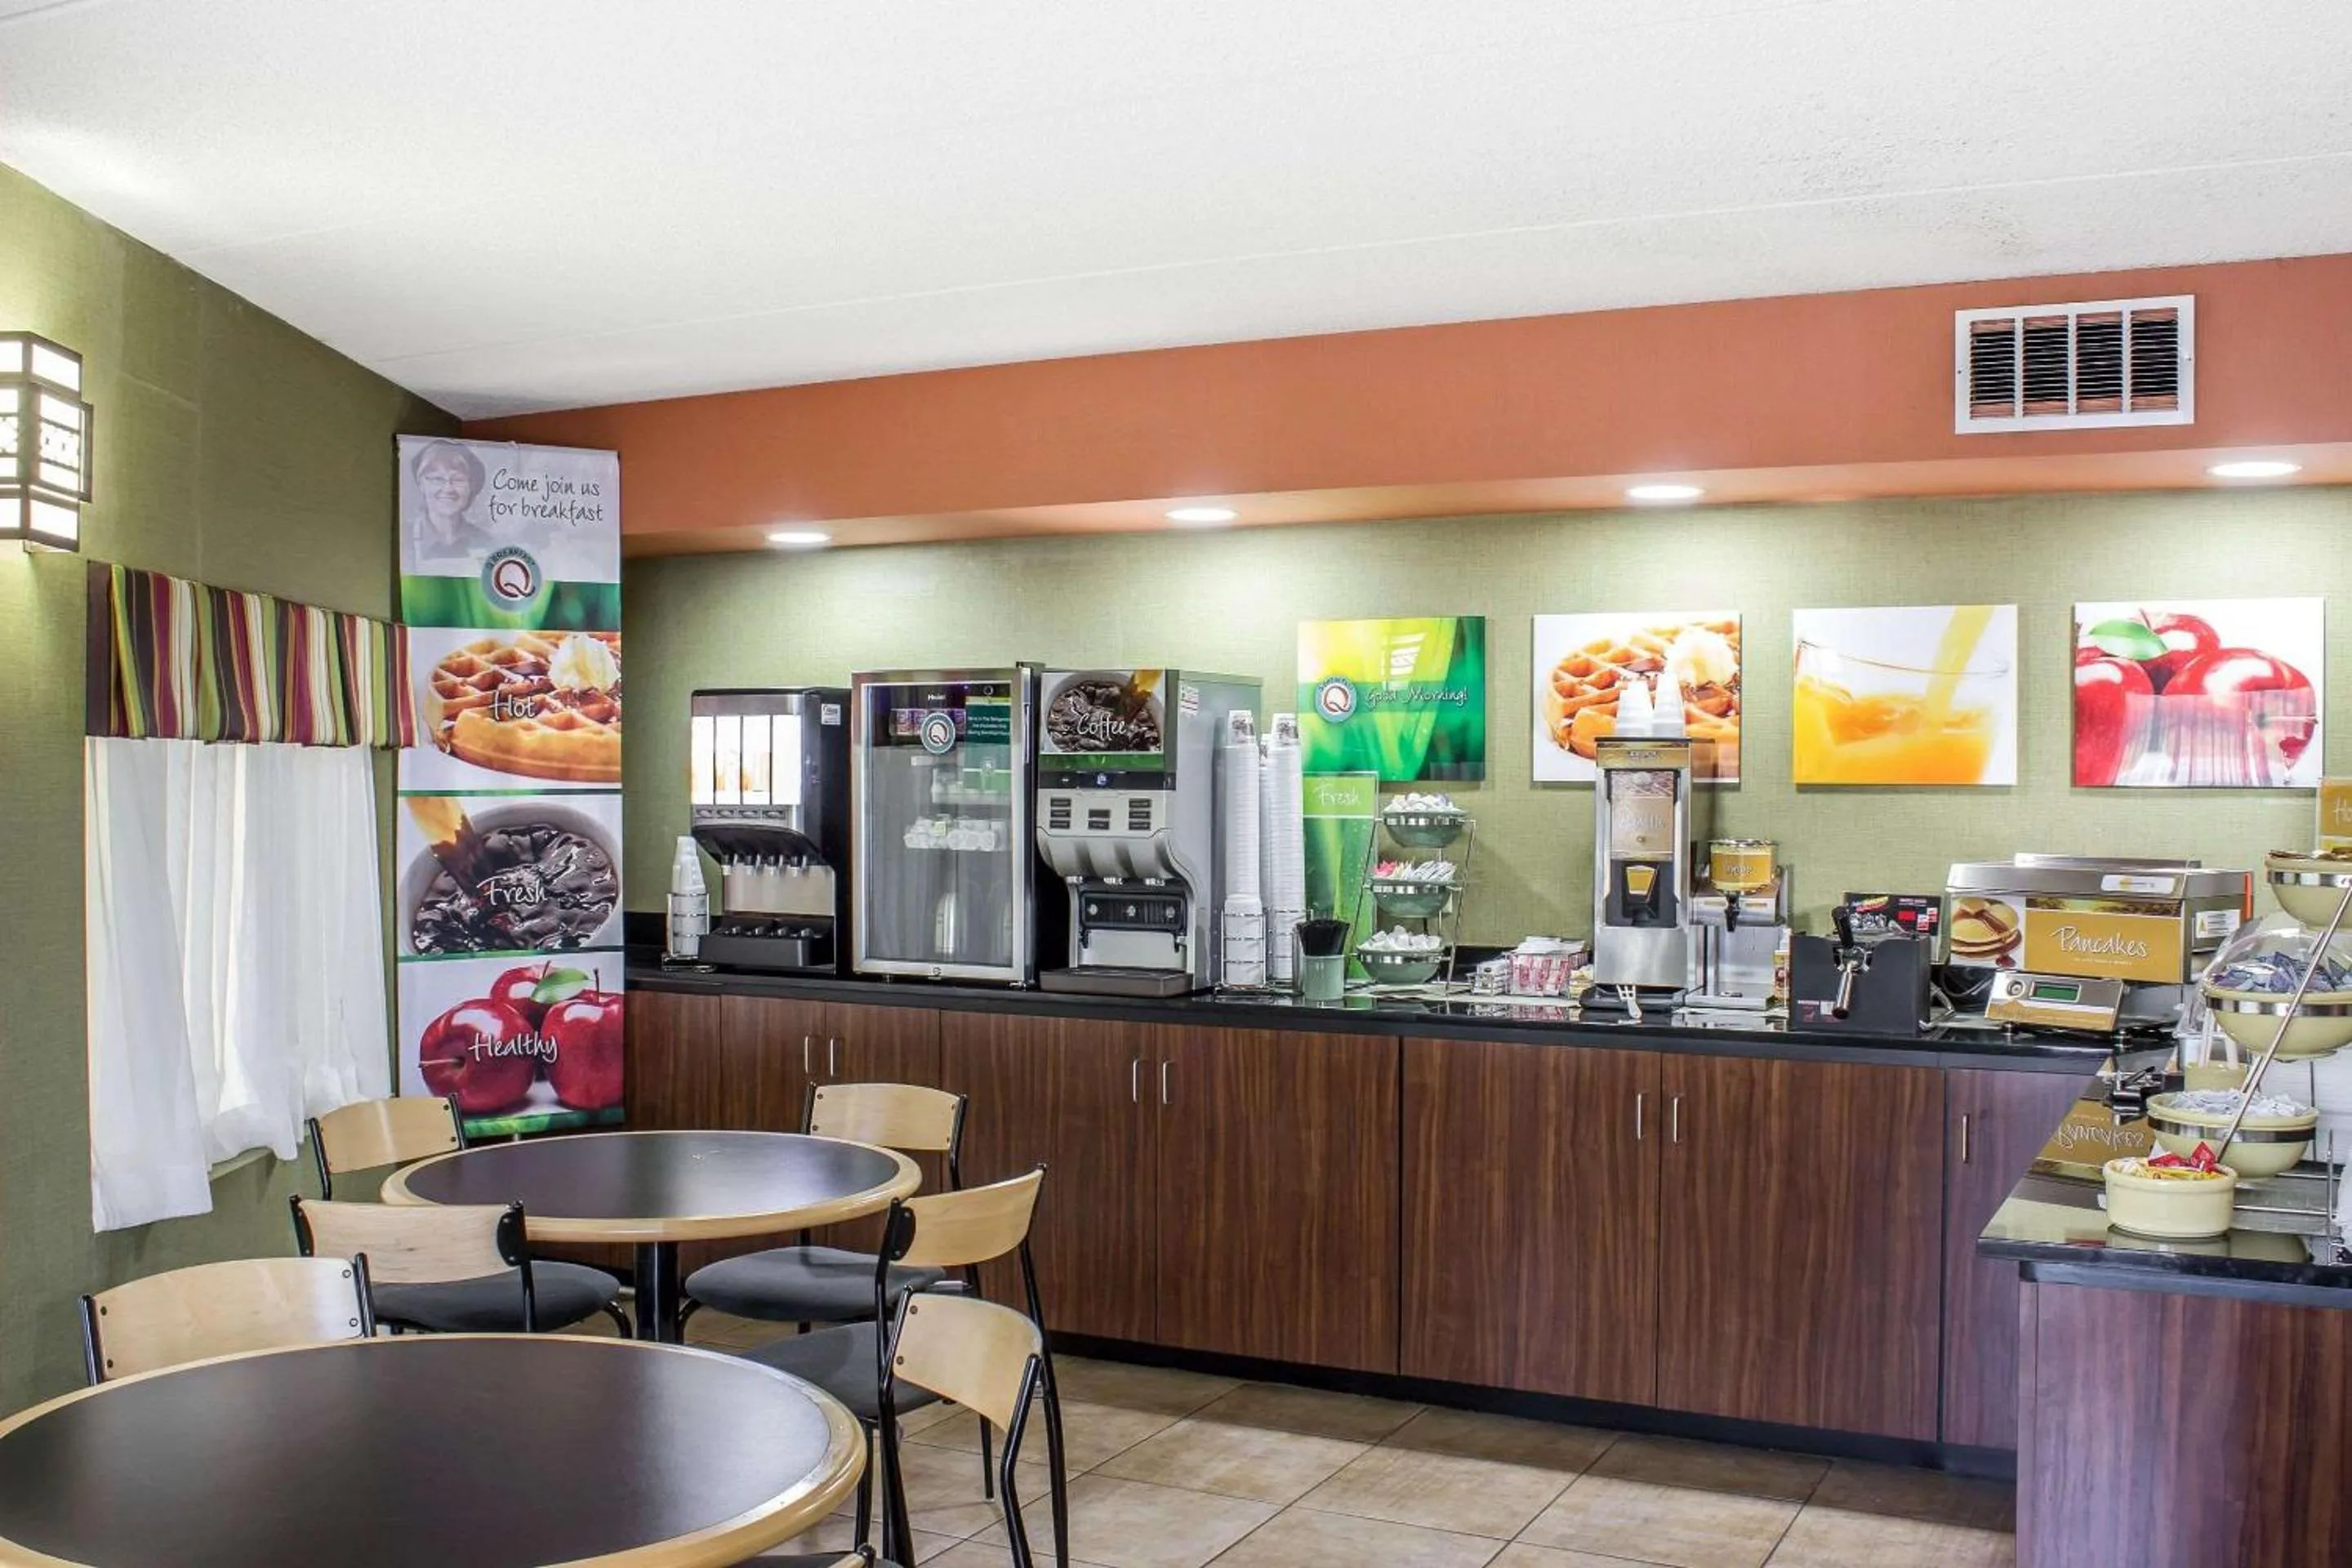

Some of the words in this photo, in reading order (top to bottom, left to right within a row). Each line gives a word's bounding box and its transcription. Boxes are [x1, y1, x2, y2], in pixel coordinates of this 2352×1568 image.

[493, 468, 539, 492] Come
[541, 474, 576, 502] join
[581, 483, 599, 497] us
[488, 494, 517, 523] for
[521, 496, 603, 526] breakfast
[493, 559, 536, 598] Q
[488, 690, 536, 720] Hot
[1323, 685, 1352, 713] Q
[1366, 688, 1398, 712] Good
[929, 721, 948, 745] Q
[1077, 712, 1127, 742] Coffee
[1312, 782, 1361, 806] Fresh
[476, 875, 548, 906] Fresh
[2049, 925, 2148, 958] Pancakes
[468, 1031, 557, 1062] Healthy
